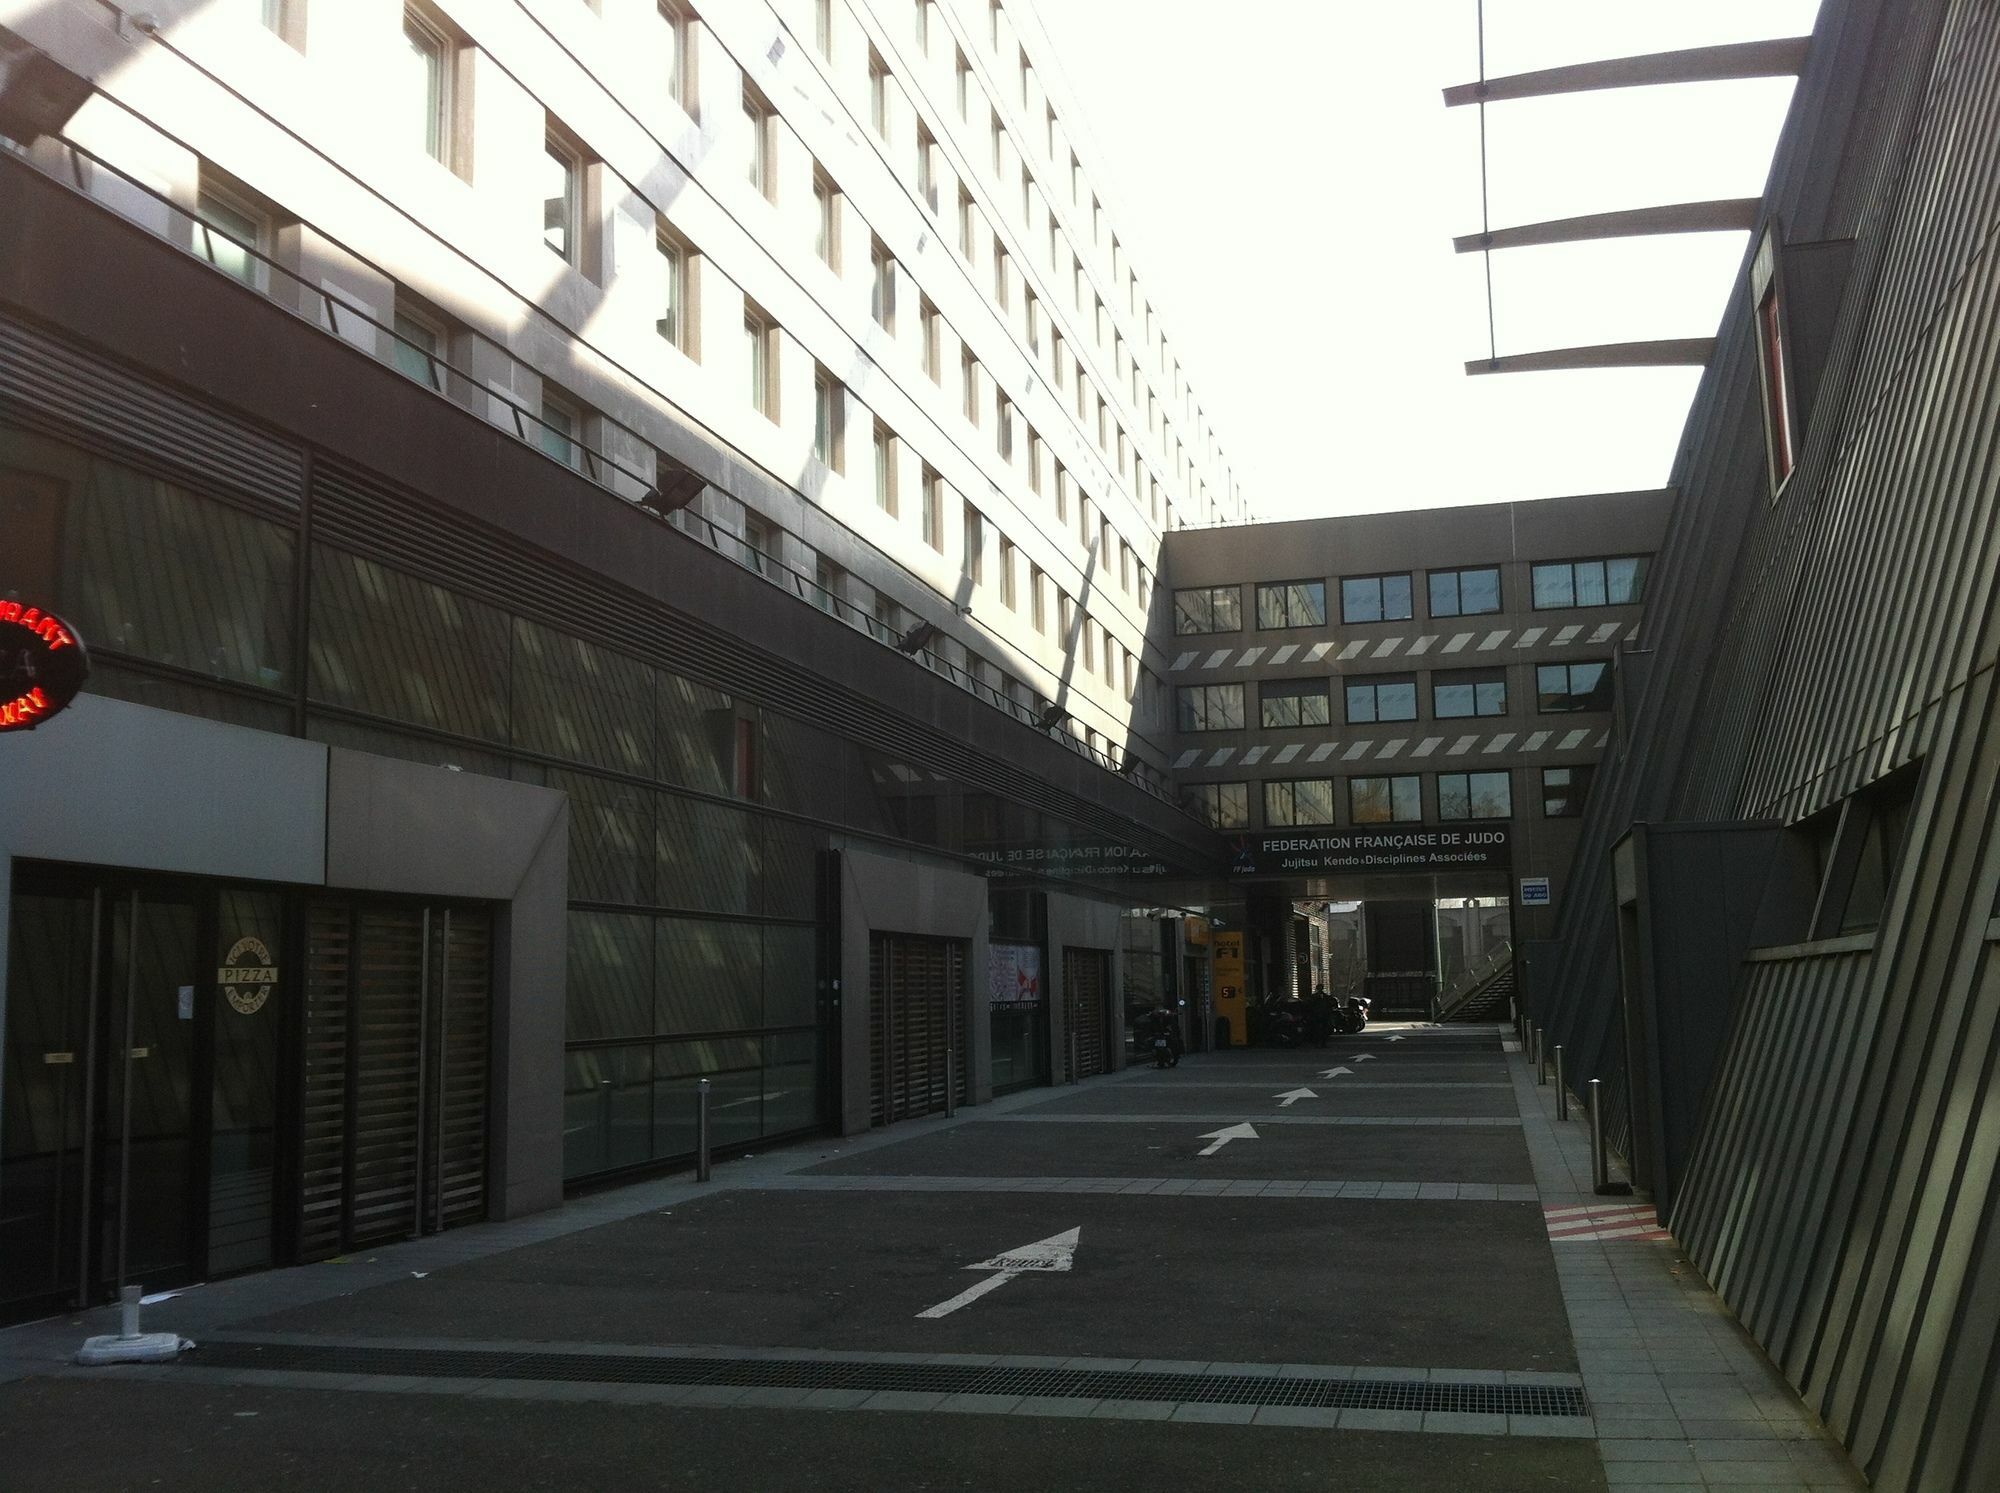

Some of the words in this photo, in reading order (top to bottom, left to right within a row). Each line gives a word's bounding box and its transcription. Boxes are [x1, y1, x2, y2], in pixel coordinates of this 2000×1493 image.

[1263, 837, 1350, 852] FEDERATION
[1355, 834, 1437, 849] FRANÇAISE
[1441, 833, 1461, 845] DE
[1465, 832, 1505, 844] JUDO
[1281, 858, 1318, 869] Jujitsu
[1429, 851, 1488, 862] Associées
[224, 969, 272, 981] PIZZA
